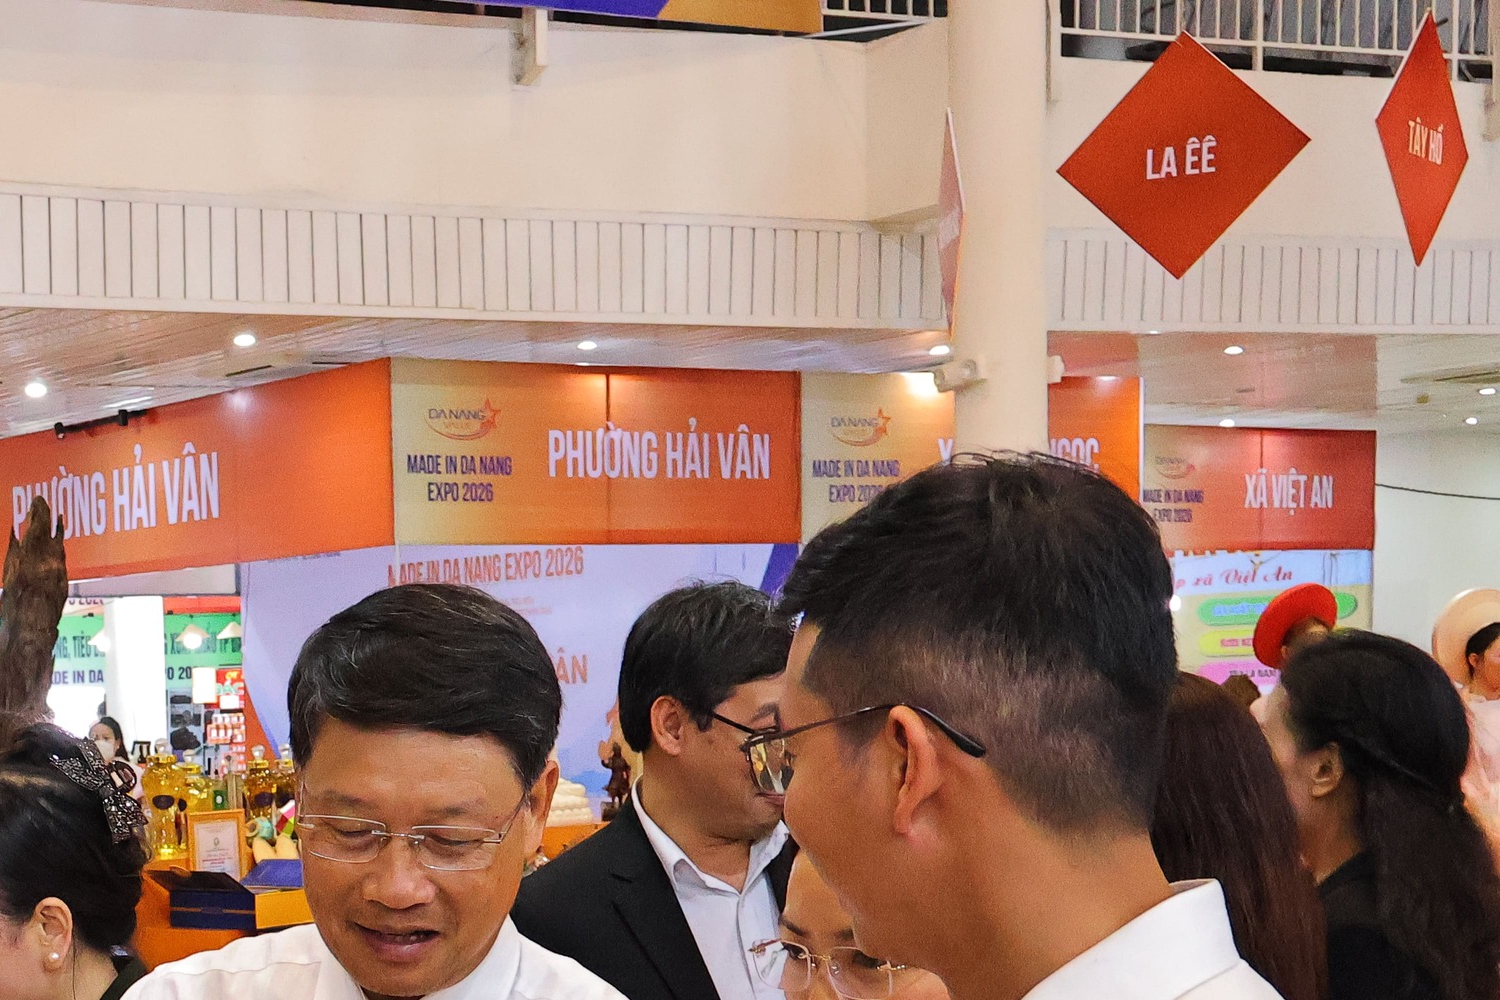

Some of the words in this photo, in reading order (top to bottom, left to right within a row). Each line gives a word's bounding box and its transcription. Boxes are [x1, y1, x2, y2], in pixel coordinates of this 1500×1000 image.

[1146, 146, 1177, 180] LA
[1185, 134, 1217, 175] ÊÊ
[1408, 116, 1428, 159] TÂY
[407, 455, 442, 475] MADE
[445, 455, 458, 475] IN
[461, 455, 477, 475] DA
[479, 456, 513, 476] NANG
[548, 420, 659, 479] PHƯỜNG
[666, 417, 710, 479] HẢI
[717, 423, 771, 480] VÂN
[812, 459, 842, 478] MADE
[857, 460, 871, 478] DA
[872, 459, 900, 478] NANG
[112, 443, 156, 532] HẢI
[162, 441, 219, 525] VÂN
[428, 482, 459, 501] EXPO
[462, 482, 494, 502] 2026
[828, 484, 856, 503] EXPO
[1244, 468, 1268, 508] XÃ
[1272, 467, 1307, 516] VIỆT
[1311, 474, 1333, 508] AN
[464, 554, 500, 584] NANG
[505, 551, 541, 581] EXPO
[545, 546, 584, 578] 2026
